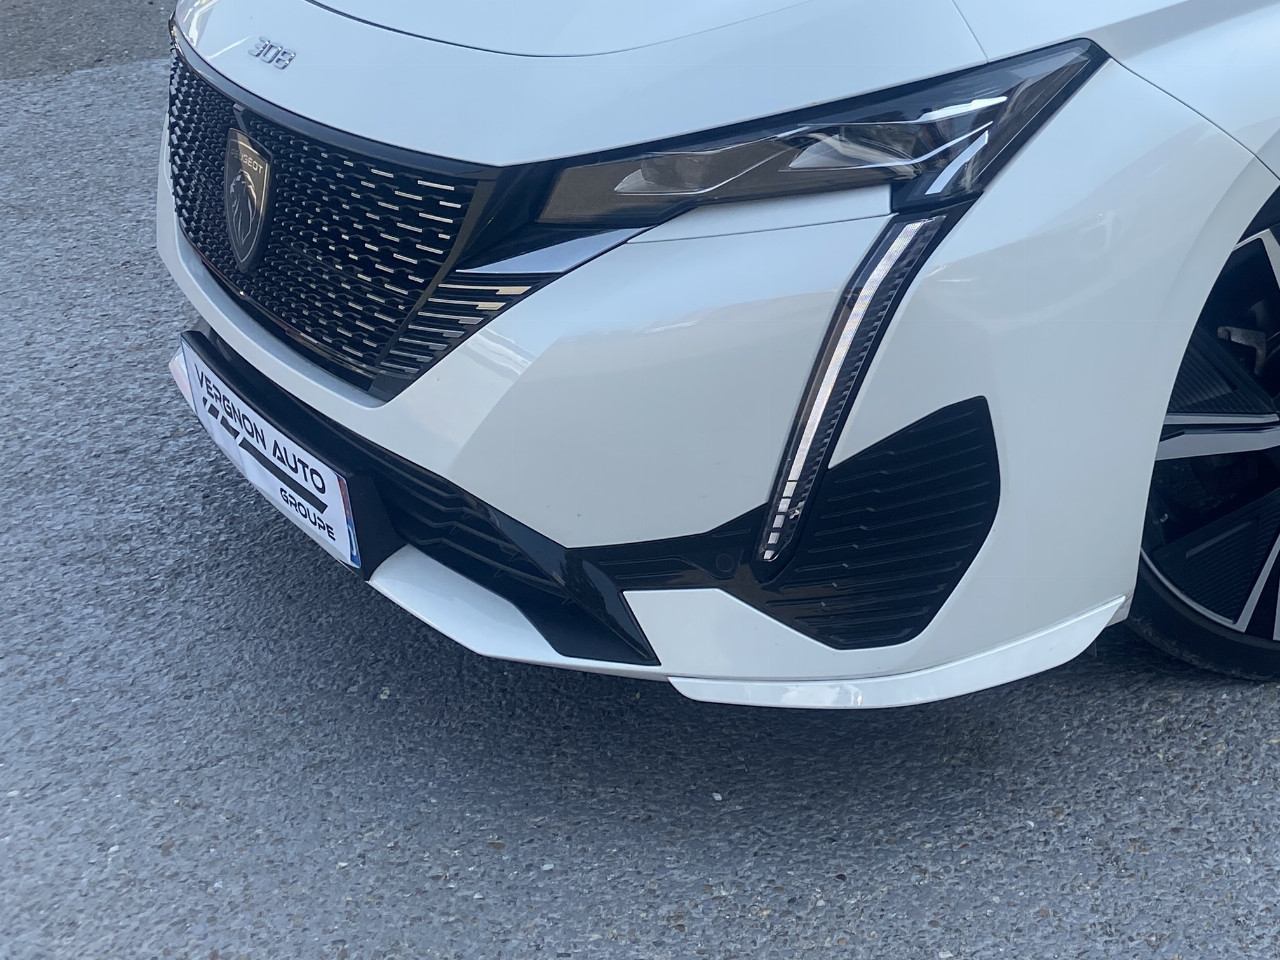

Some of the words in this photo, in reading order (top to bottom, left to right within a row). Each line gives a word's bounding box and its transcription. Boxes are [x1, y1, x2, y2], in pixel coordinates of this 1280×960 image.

[248, 36, 297, 70] 308
[194, 362, 268, 450] VERGNON
[272, 439, 327, 495] AUTO
[279, 486, 337, 542] GROUPE
